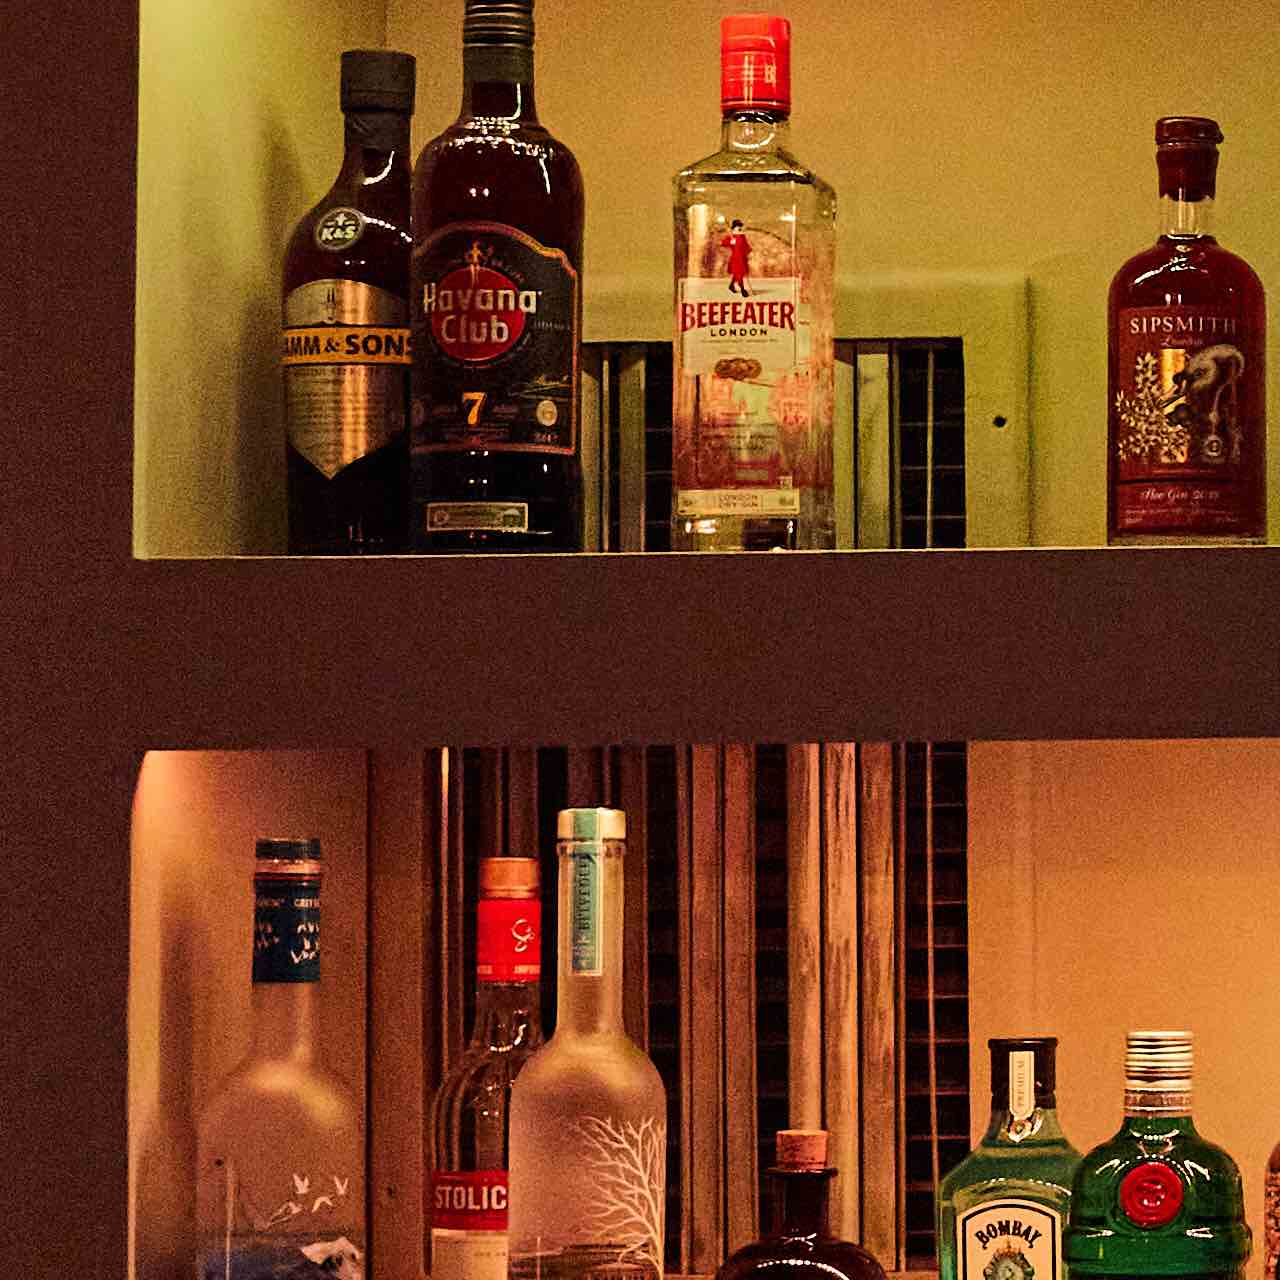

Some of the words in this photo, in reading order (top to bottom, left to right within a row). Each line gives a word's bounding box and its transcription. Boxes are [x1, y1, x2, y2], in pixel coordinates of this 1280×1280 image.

[423, 282, 537, 314] Havana
[441, 313, 510, 344] Club
[680, 300, 796, 333] BEEFEATER
[1129, 316, 1237, 335] SIPSMITH
[710, 327, 768, 338] LONDON
[462, 392, 487, 425] 7
[975, 1220, 1042, 1250] BOMBAY
